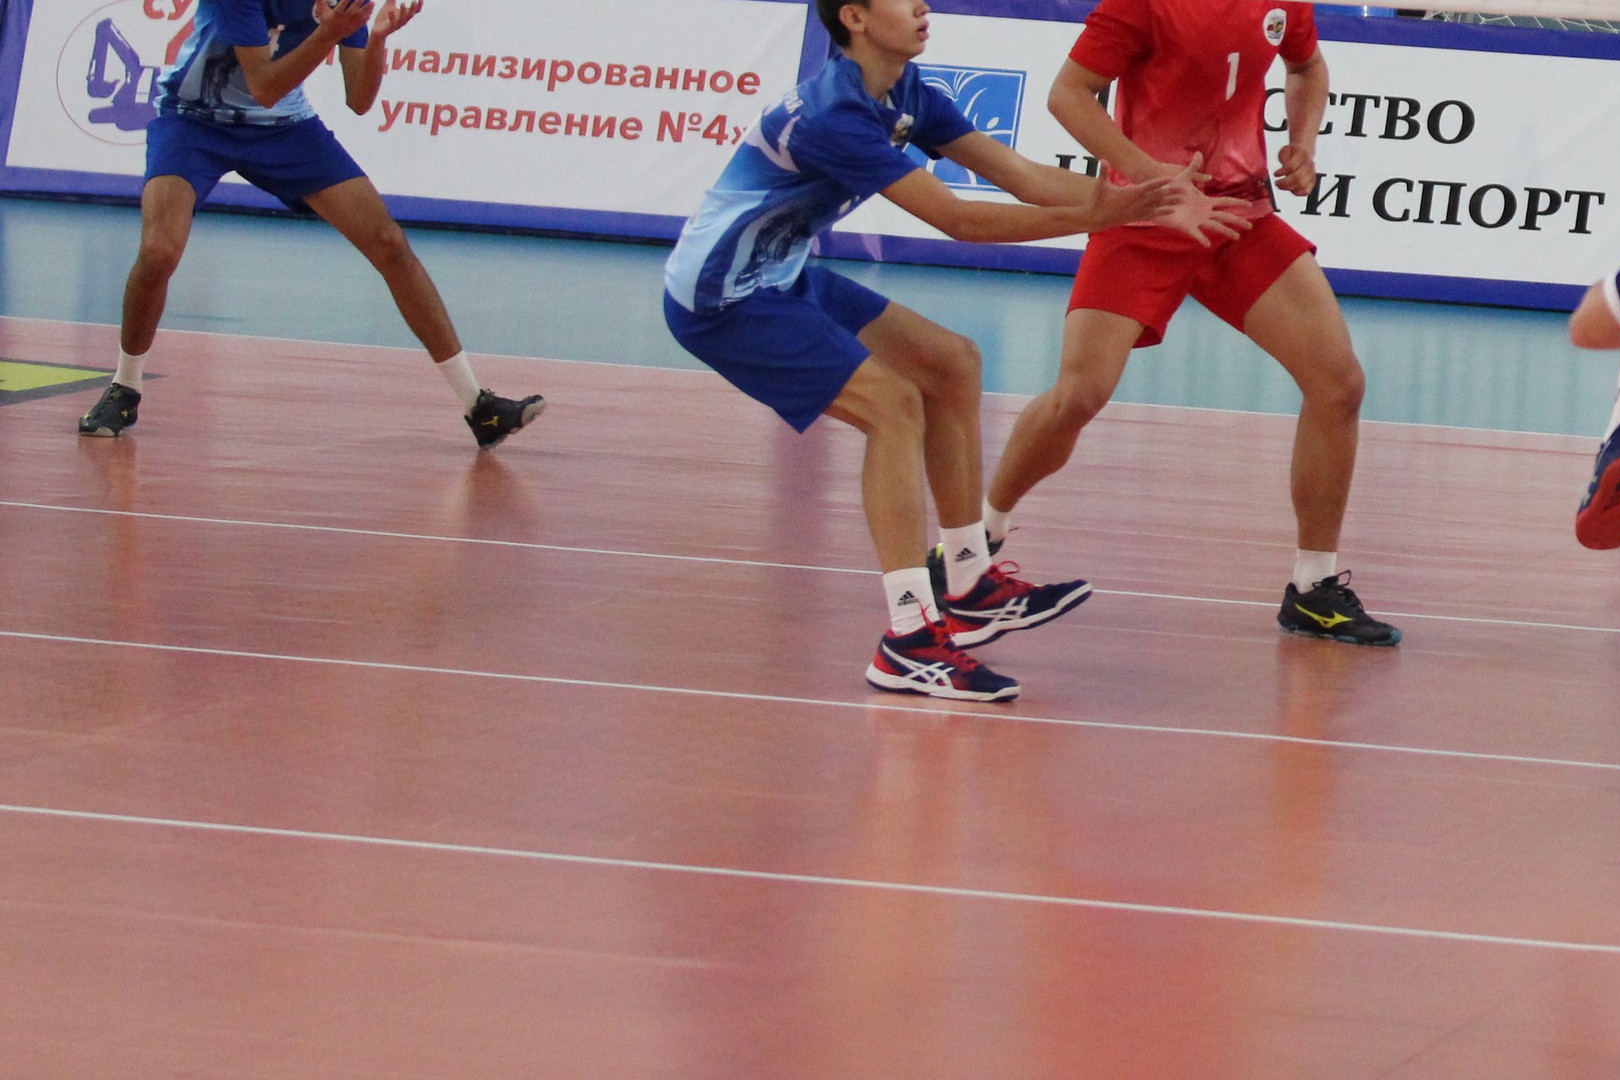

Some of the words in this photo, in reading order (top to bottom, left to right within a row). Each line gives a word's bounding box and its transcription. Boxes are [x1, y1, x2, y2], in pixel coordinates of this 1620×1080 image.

[1227, 52, 1240, 100] 1
[378, 99, 643, 140] управление
[1300, 173, 1356, 218] И
[1373, 177, 1605, 234] СПОРТ
